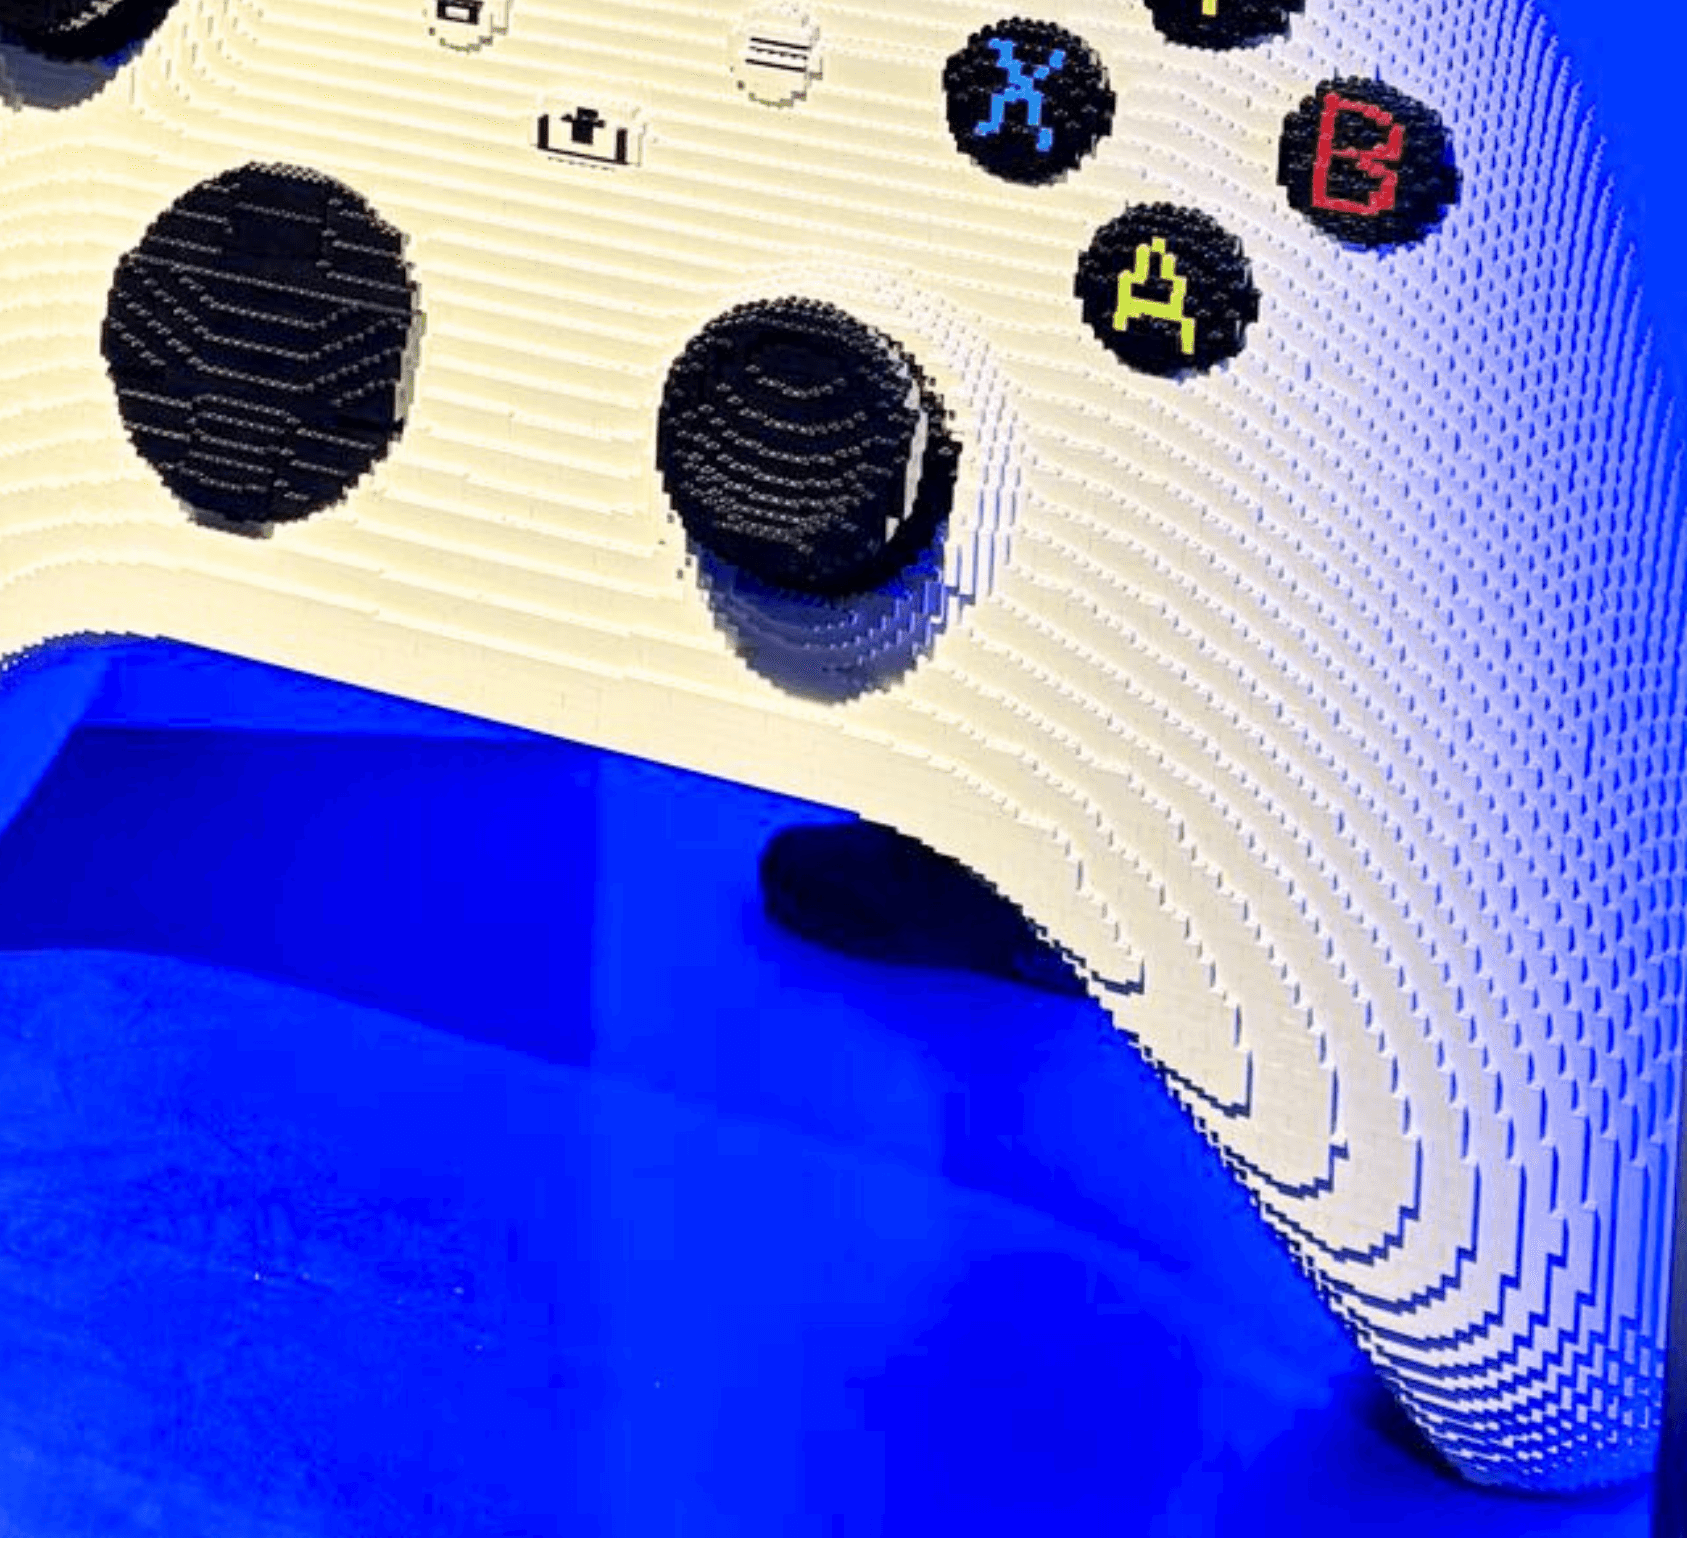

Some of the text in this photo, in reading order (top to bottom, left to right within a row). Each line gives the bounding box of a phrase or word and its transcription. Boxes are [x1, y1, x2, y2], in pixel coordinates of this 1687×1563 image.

[972, 37, 1066, 154] X
[1311, 92, 1405, 217] B
[1111, 236, 1197, 356] A
